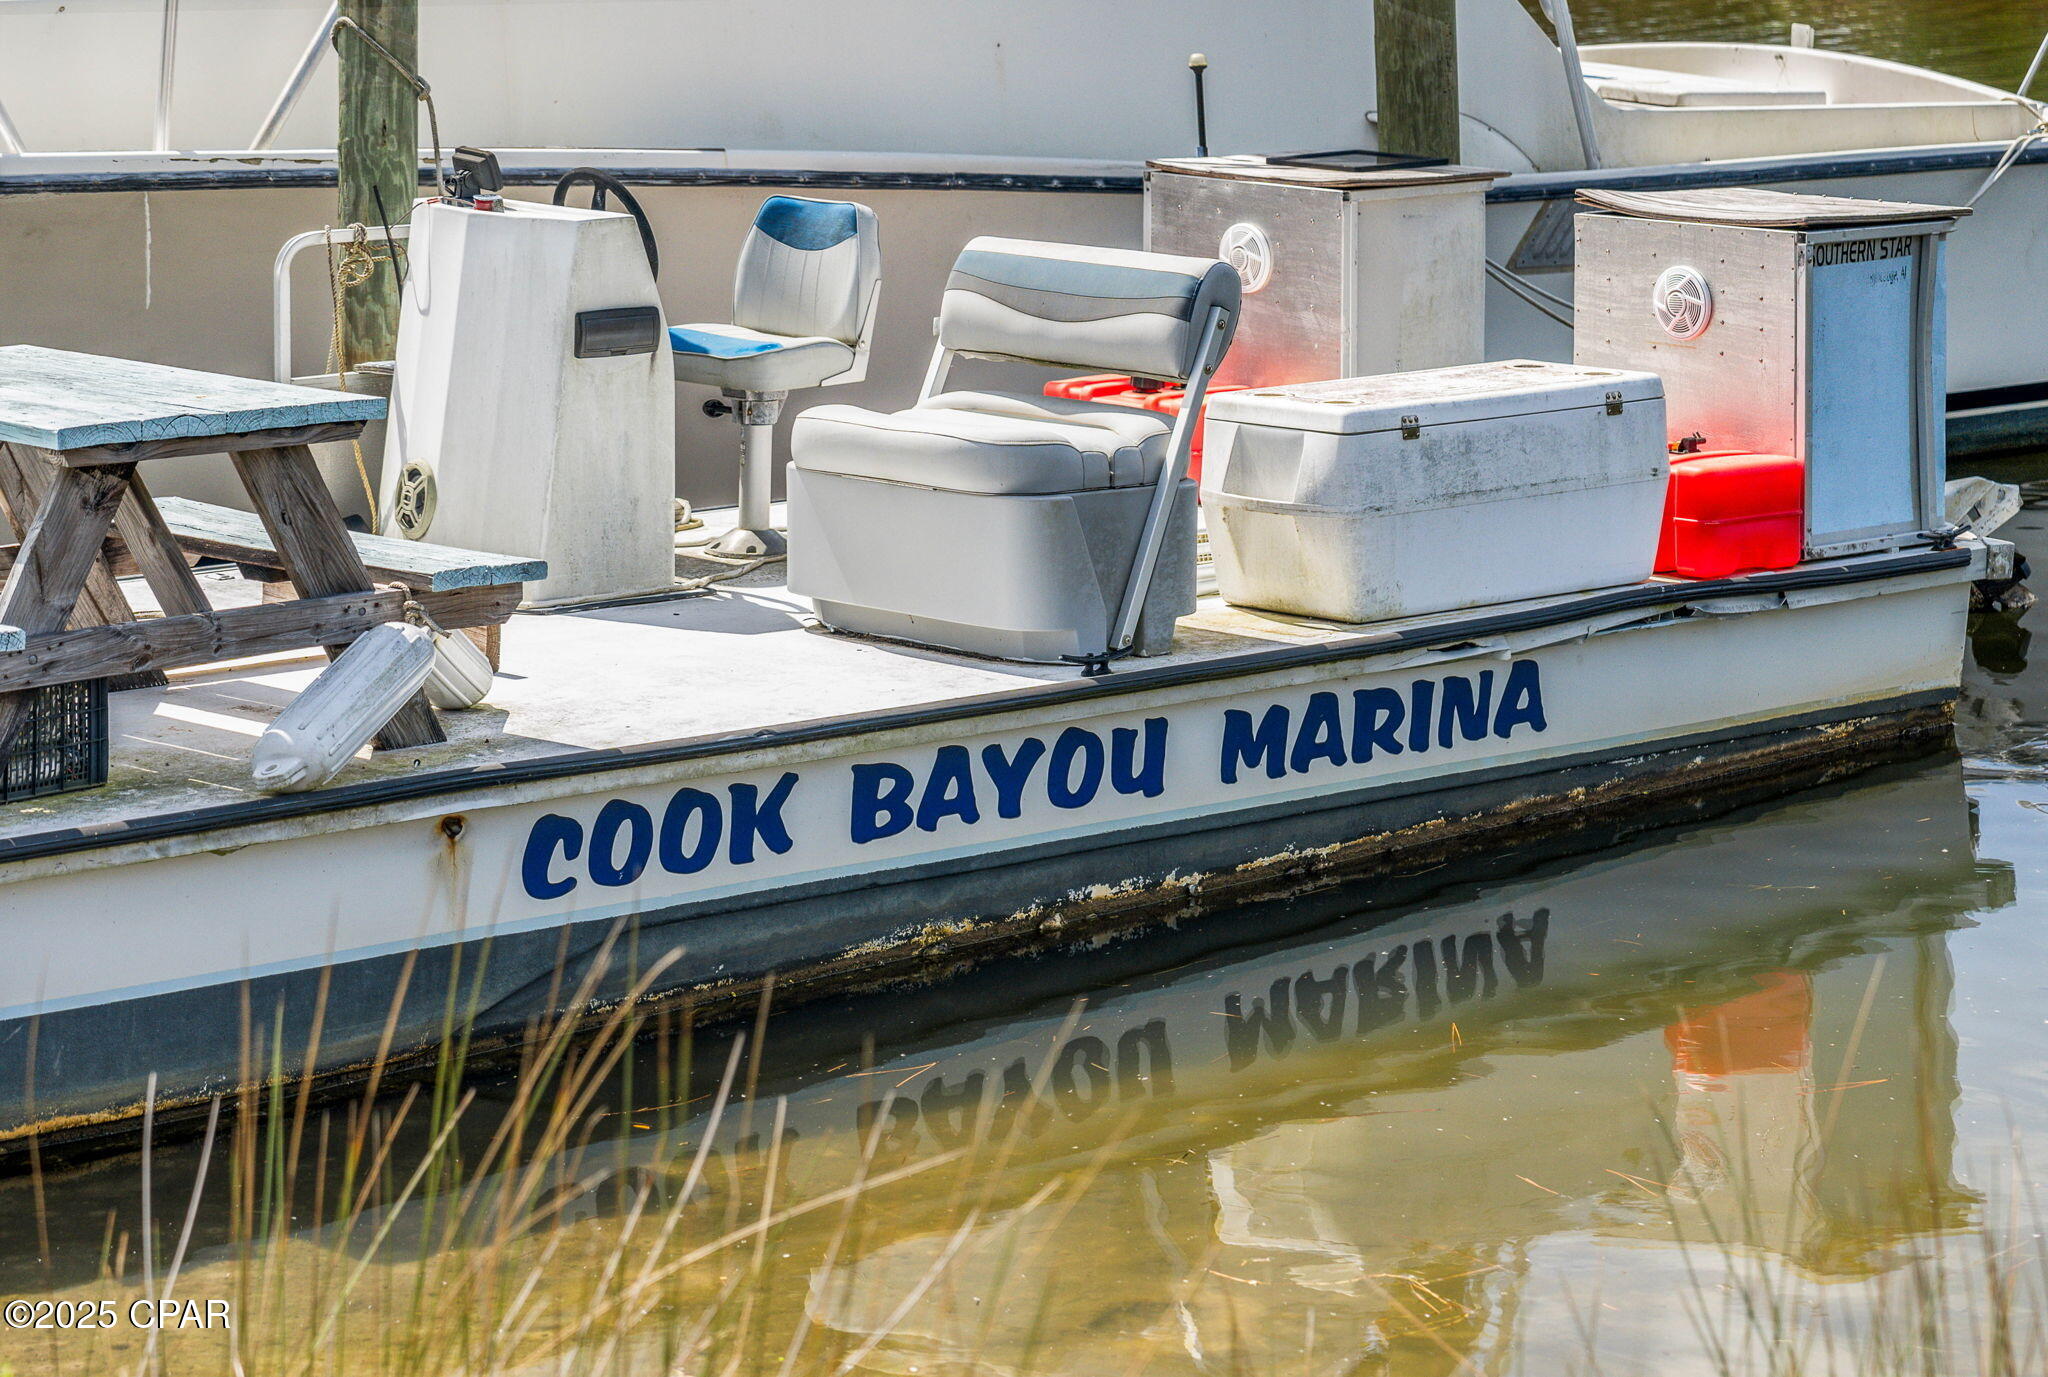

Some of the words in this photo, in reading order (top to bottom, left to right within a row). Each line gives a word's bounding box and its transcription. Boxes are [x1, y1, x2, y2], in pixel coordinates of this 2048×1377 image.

[1880, 236, 1912, 259] STAR
[522, 772, 799, 900] COOK
[850, 717, 1168, 844] BAYOU
[1220, 659, 1547, 784] MARINA
